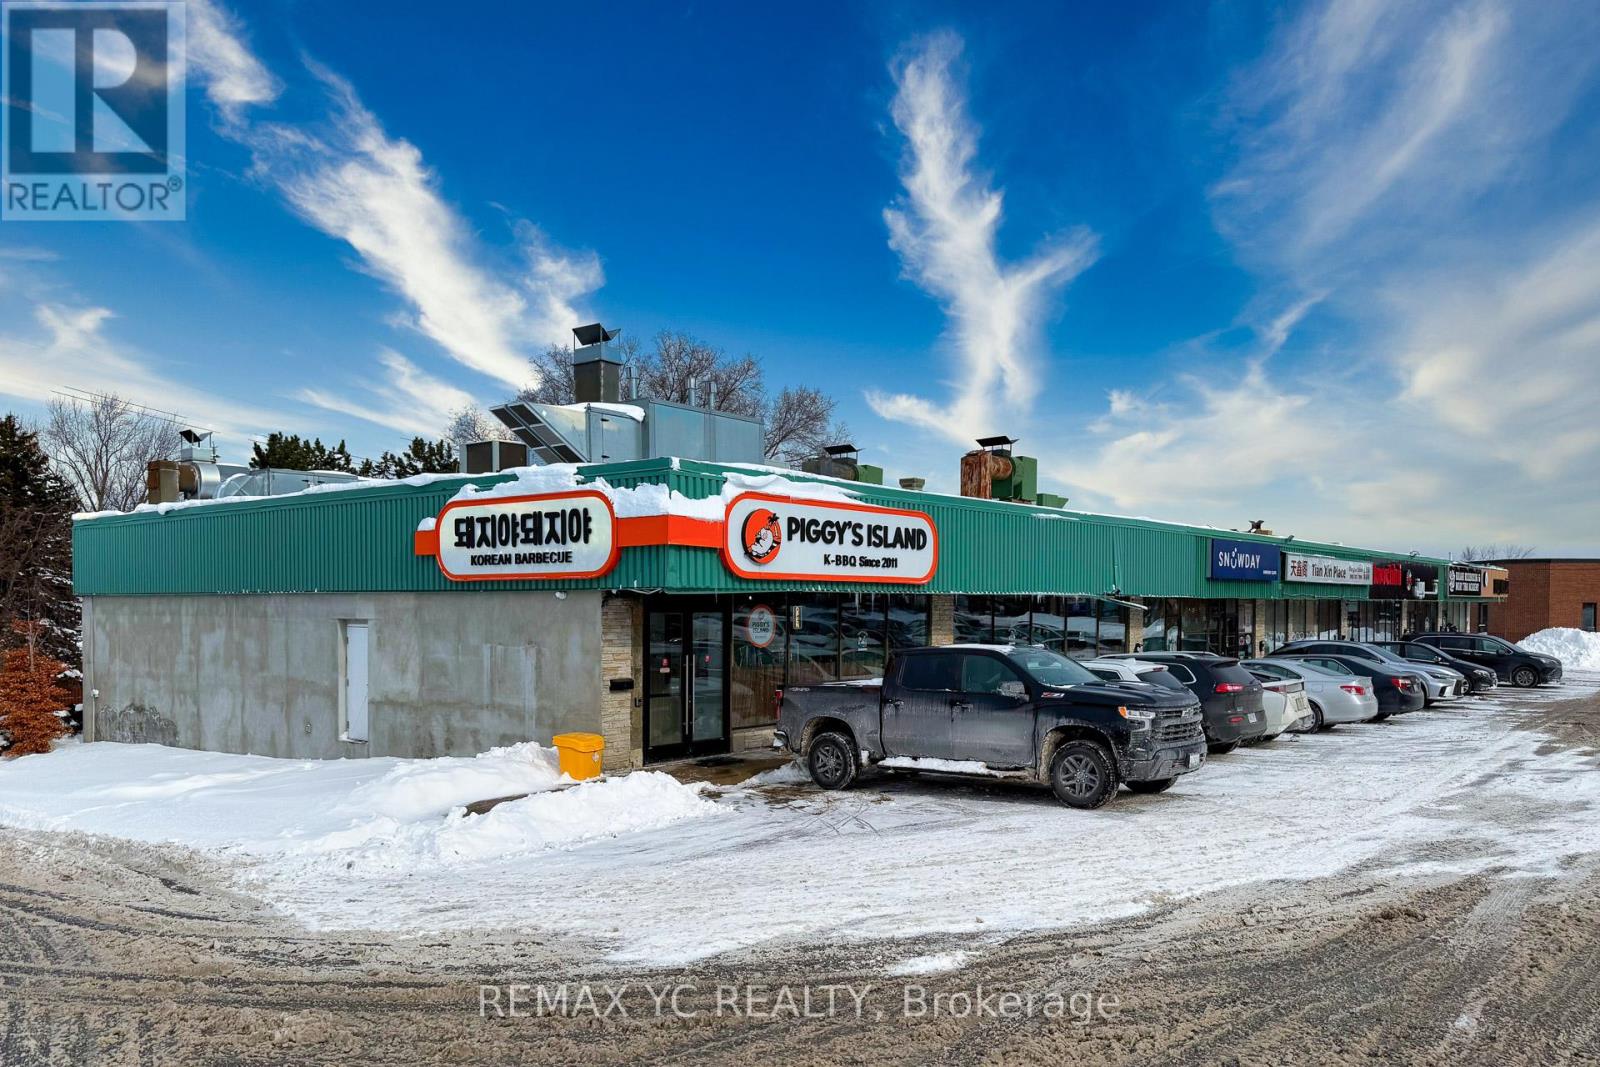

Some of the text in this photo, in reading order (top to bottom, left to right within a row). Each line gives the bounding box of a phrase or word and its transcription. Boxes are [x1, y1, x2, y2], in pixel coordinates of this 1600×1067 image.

[454, 507, 593, 549] 돼지야돼지야
[787, 516, 928, 550] PIGGY'S ISLAND
[470, 551, 573, 566] KOREAN BARBECUE
[823, 553, 898, 568] K-BBQ Since 2011
